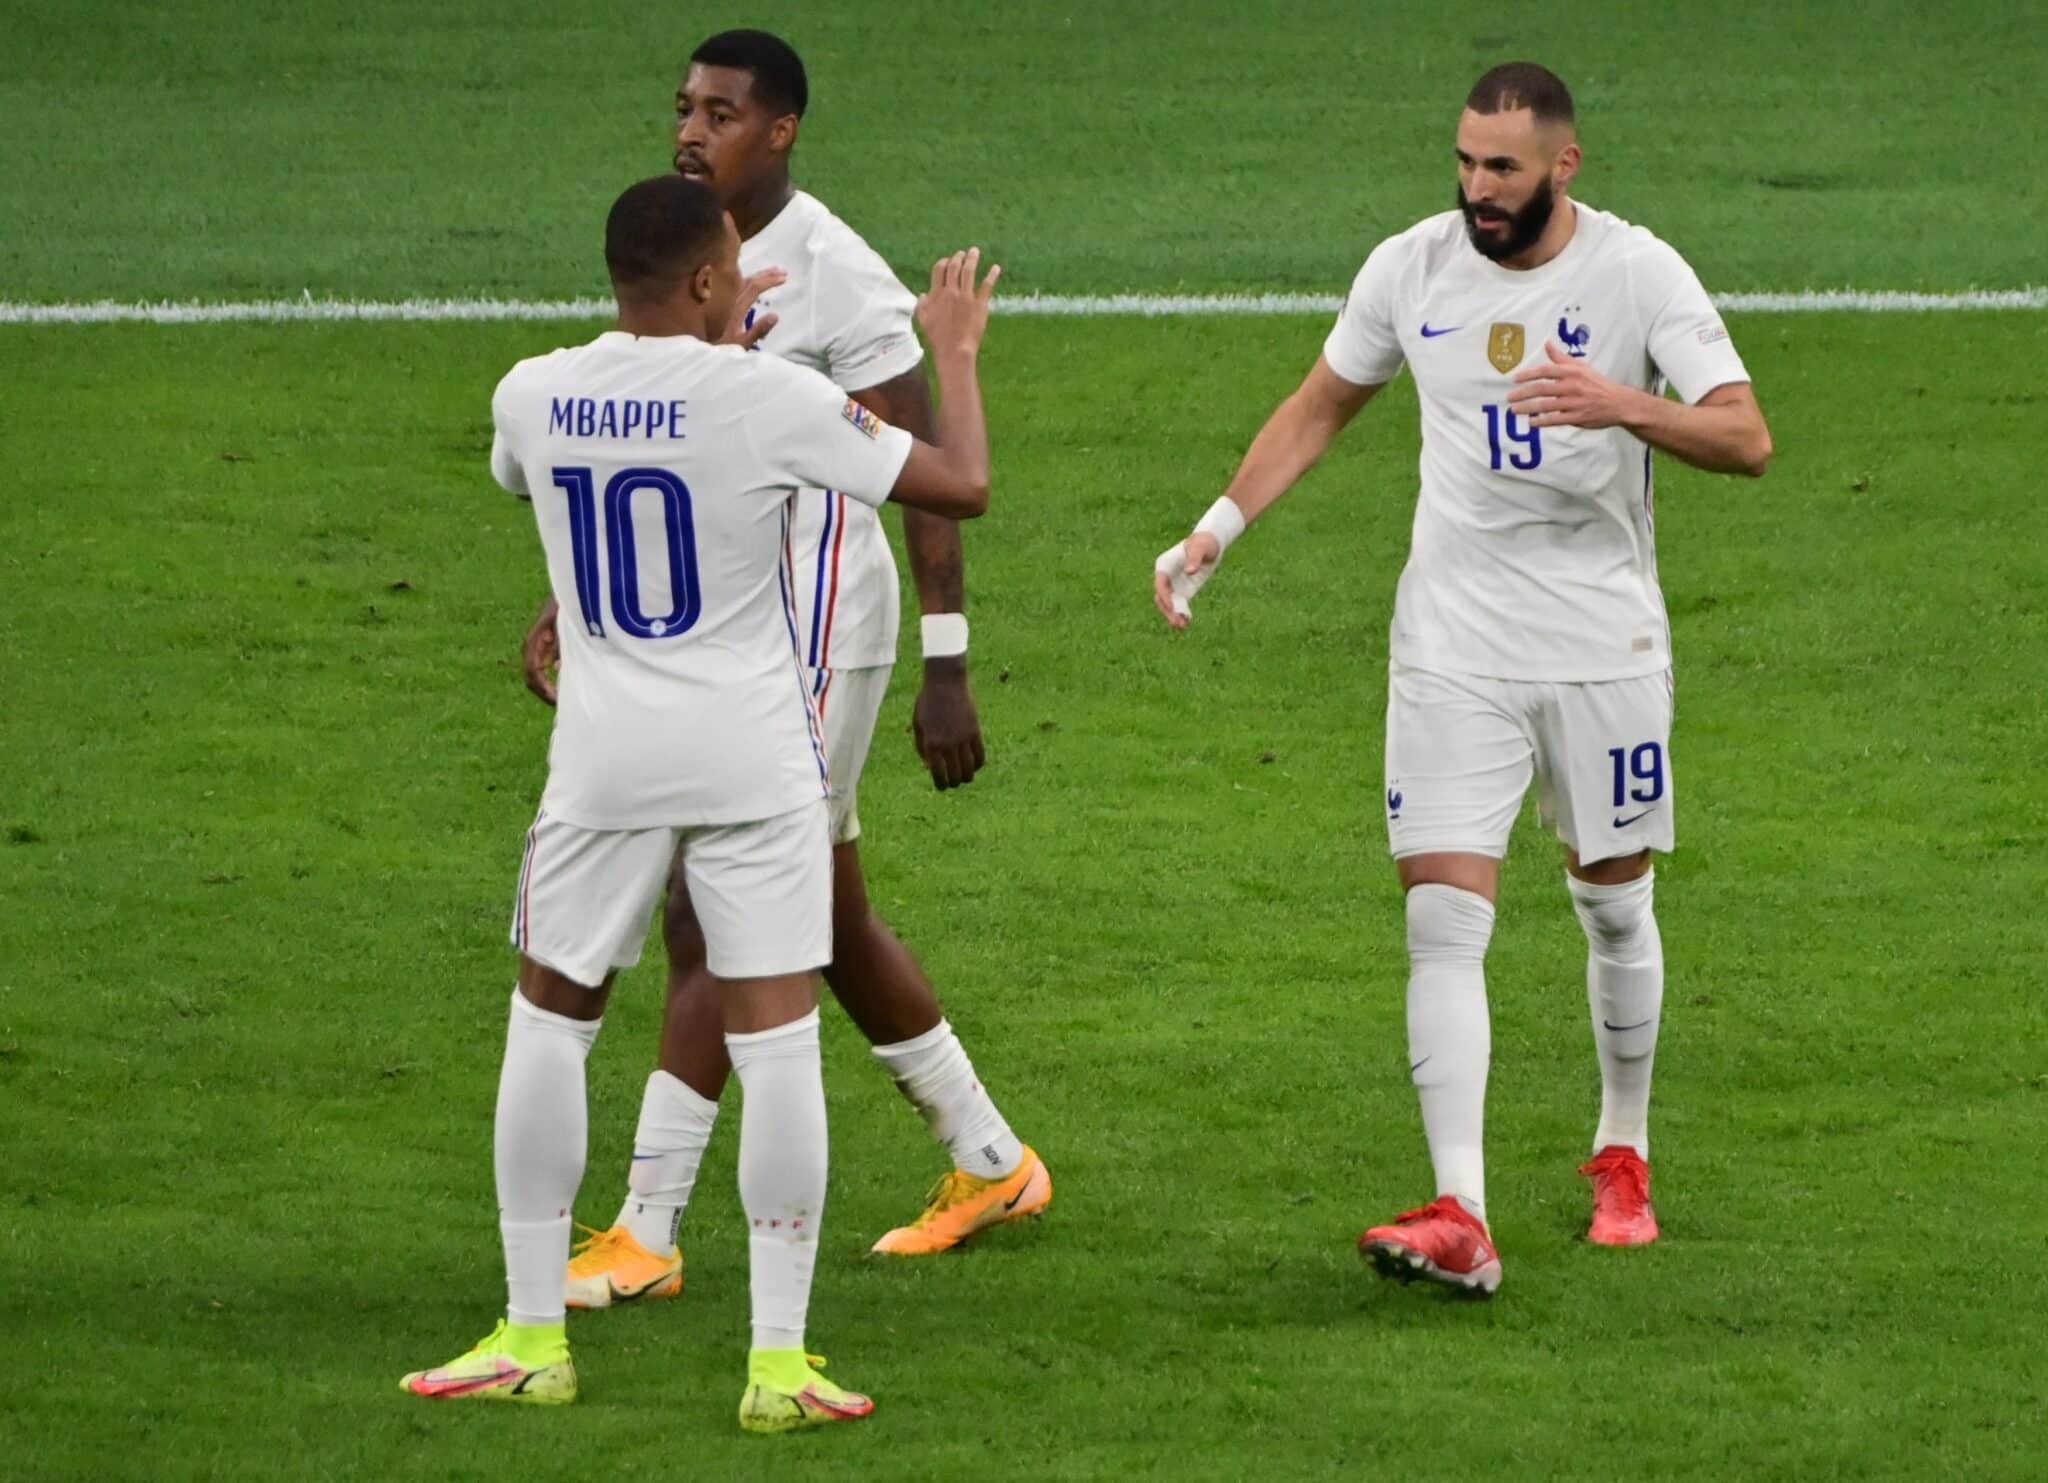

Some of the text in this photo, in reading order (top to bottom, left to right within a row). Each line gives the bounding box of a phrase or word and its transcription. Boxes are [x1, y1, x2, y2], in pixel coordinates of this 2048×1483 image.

[549, 397, 687, 439] MBAPPE
[1481, 404, 1542, 471] 19
[552, 467, 701, 639] 10
[1608, 740, 1664, 807] 19
